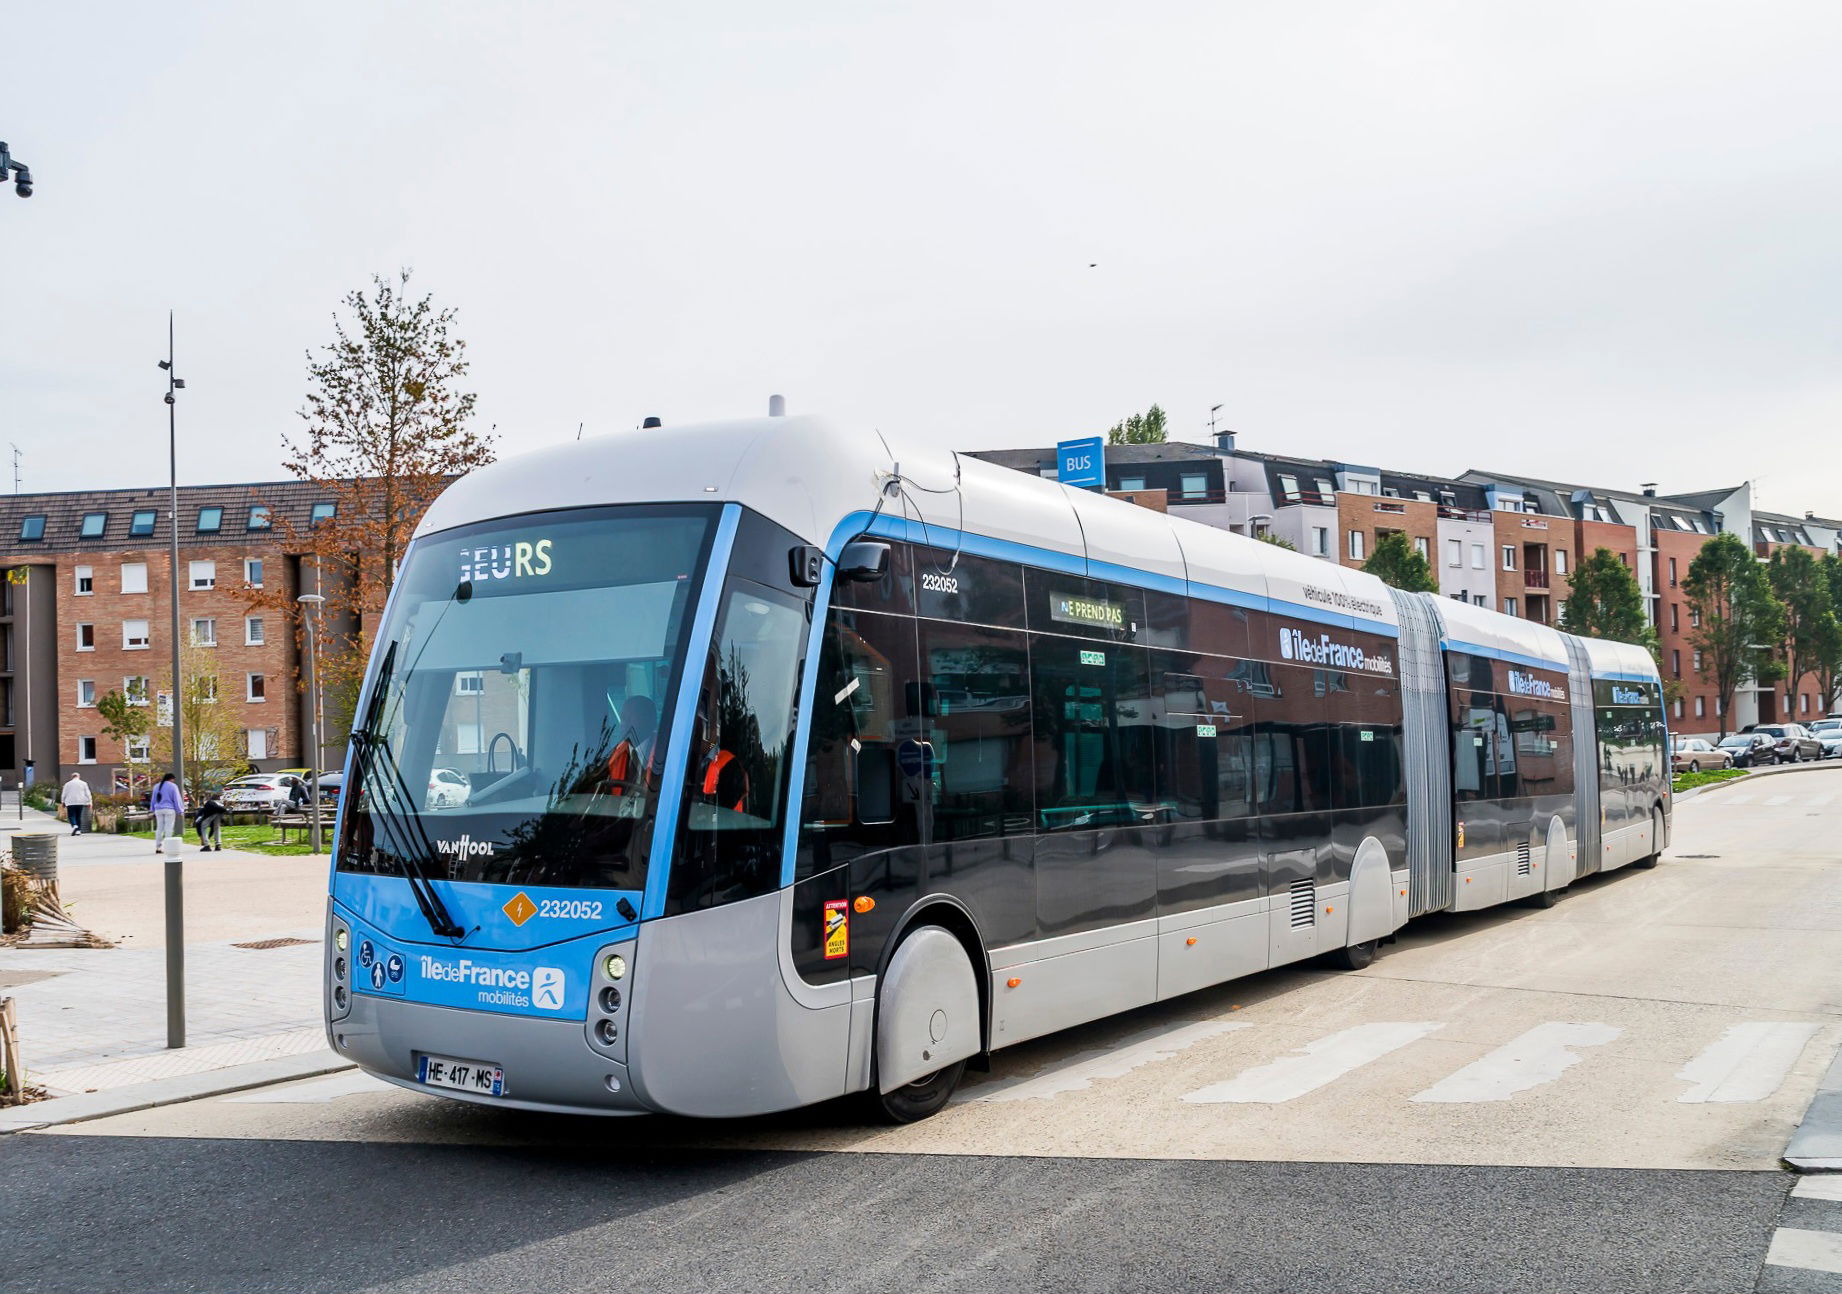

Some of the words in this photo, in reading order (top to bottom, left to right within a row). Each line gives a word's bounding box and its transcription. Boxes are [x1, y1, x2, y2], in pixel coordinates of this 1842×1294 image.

[1066, 455, 1091, 472] BUS
[922, 573, 959, 594] 232052
[1061, 600, 1074, 616] NE
[1075, 602, 1105, 621] PREND
[1106, 607, 1122, 623] PAS
[540, 900, 602, 920] 232052
[478, 991, 529, 1008] mobilités
